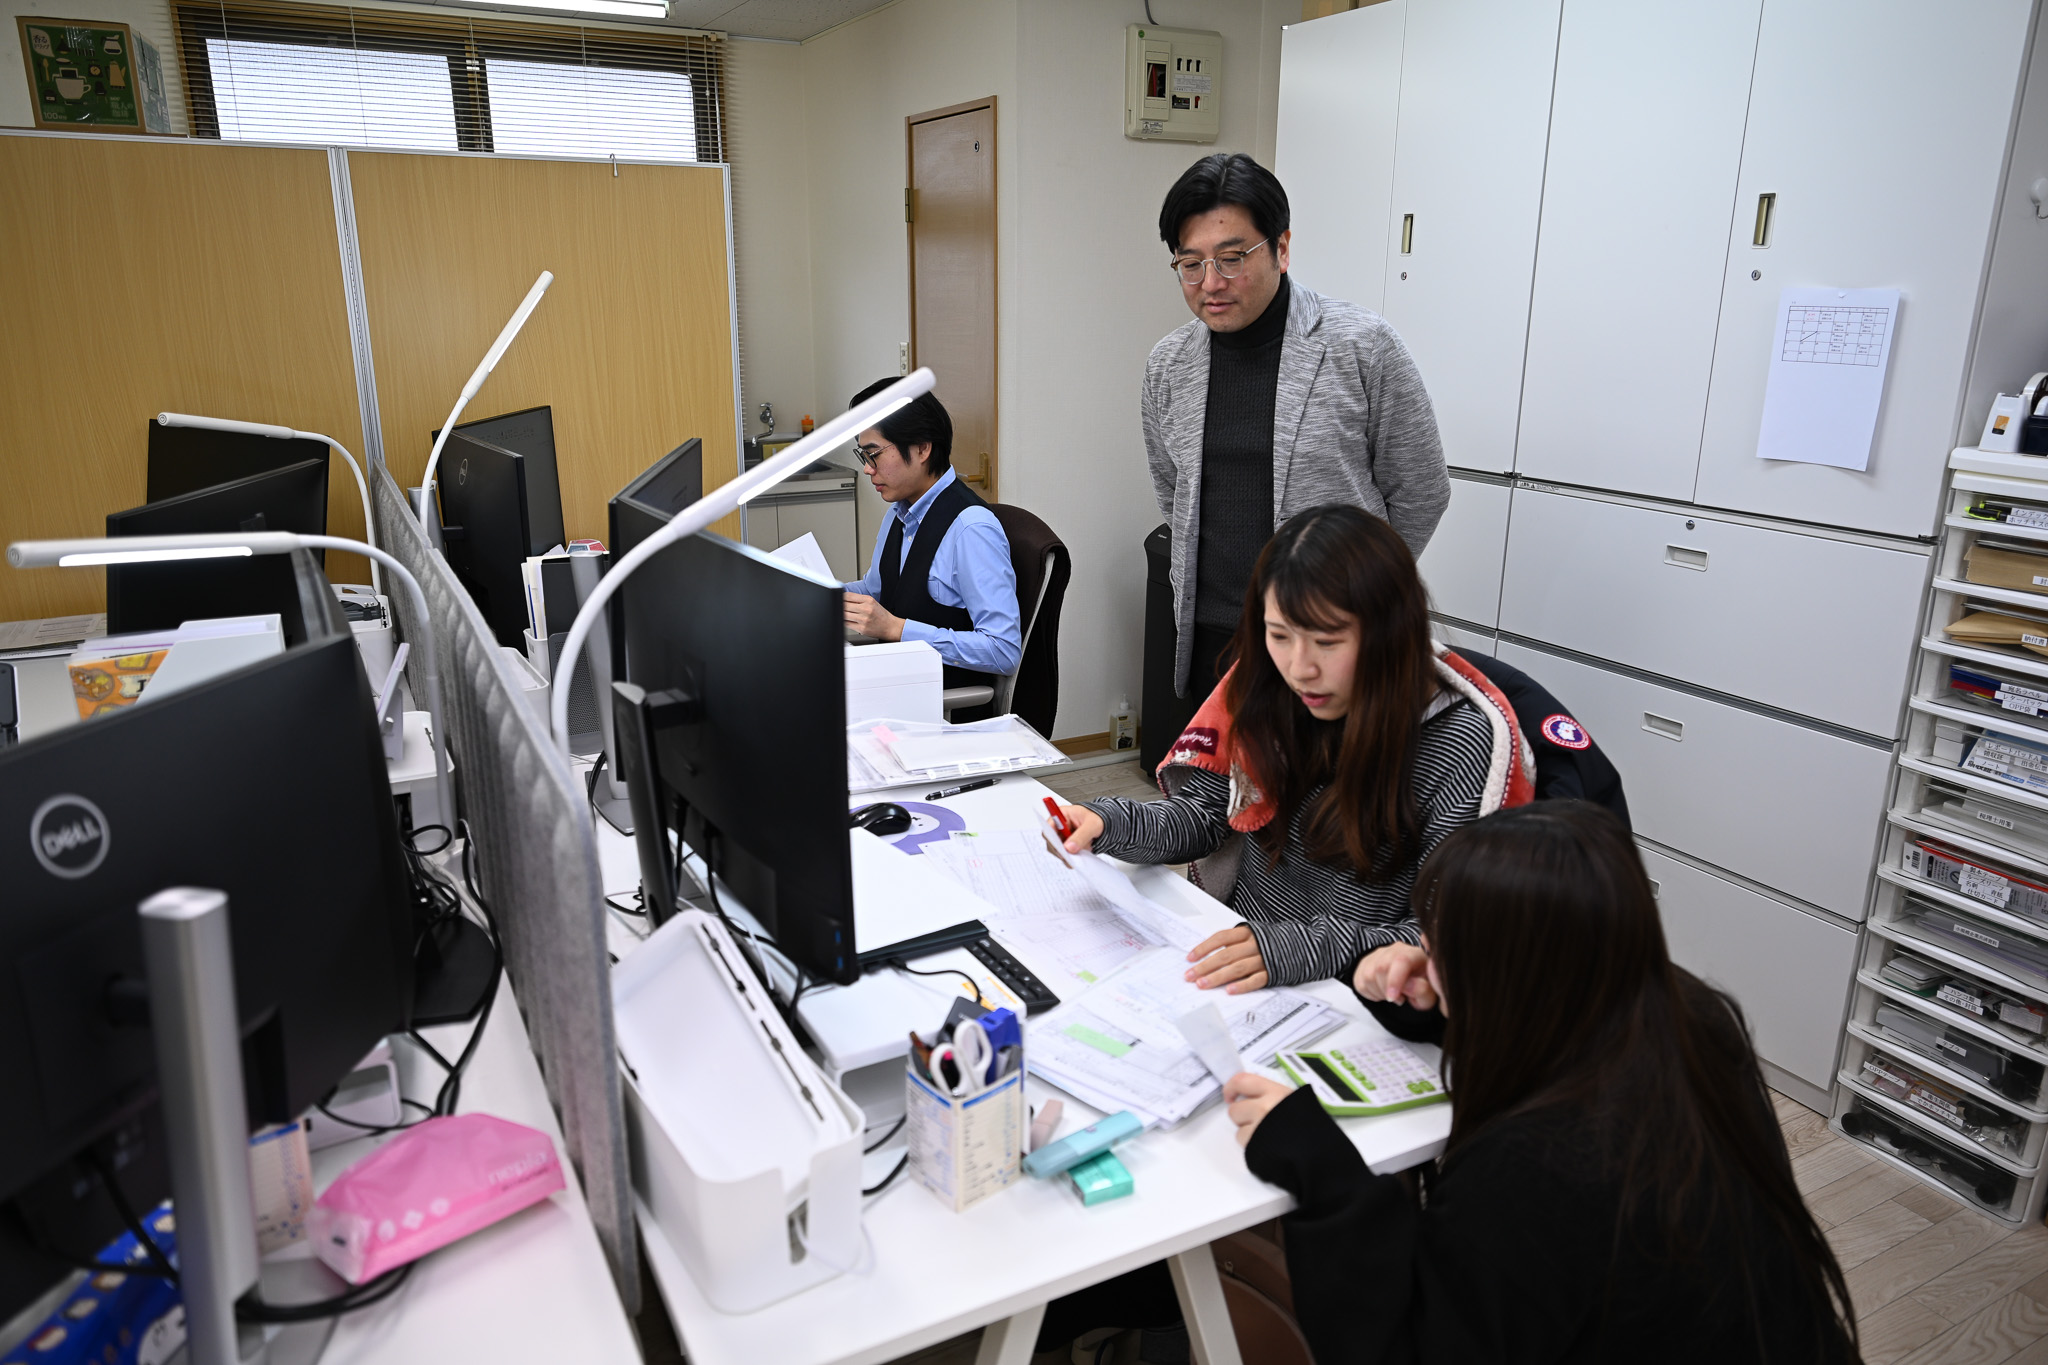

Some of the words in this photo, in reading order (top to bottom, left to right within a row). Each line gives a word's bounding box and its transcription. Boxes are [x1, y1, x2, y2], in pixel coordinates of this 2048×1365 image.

[2024, 635, 2045, 646] 納付書
[2007, 685, 2042, 698] 宛名ラベル
[2003, 693, 2043, 708] レターパック
[2009, 702, 2031, 714] OPP袋
[1982, 761, 2000, 770] ノート
[42, 815, 101, 858] DELL
